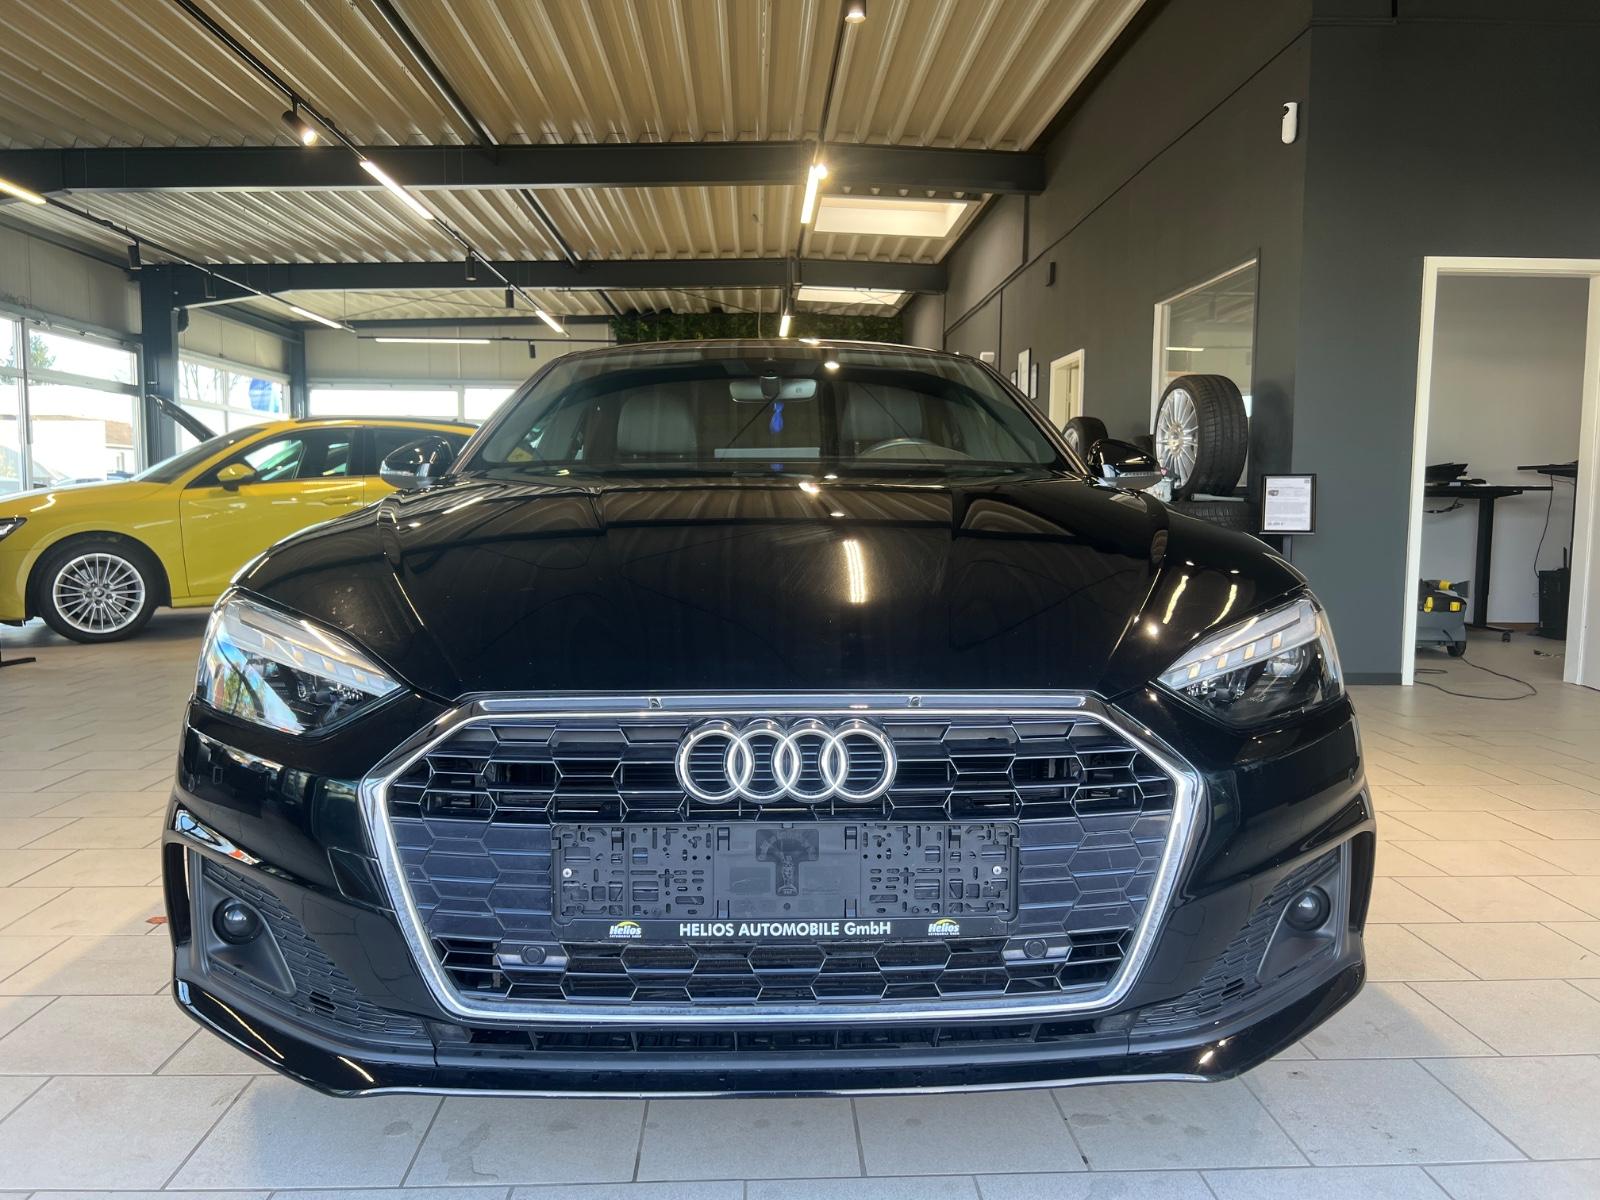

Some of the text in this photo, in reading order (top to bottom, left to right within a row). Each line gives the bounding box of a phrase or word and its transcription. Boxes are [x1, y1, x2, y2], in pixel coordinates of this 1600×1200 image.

[609, 925, 642, 935] Helios
[679, 921, 891, 937] HELIOS AUTOMOBILE GmbH
[928, 923, 960, 933] Helios
